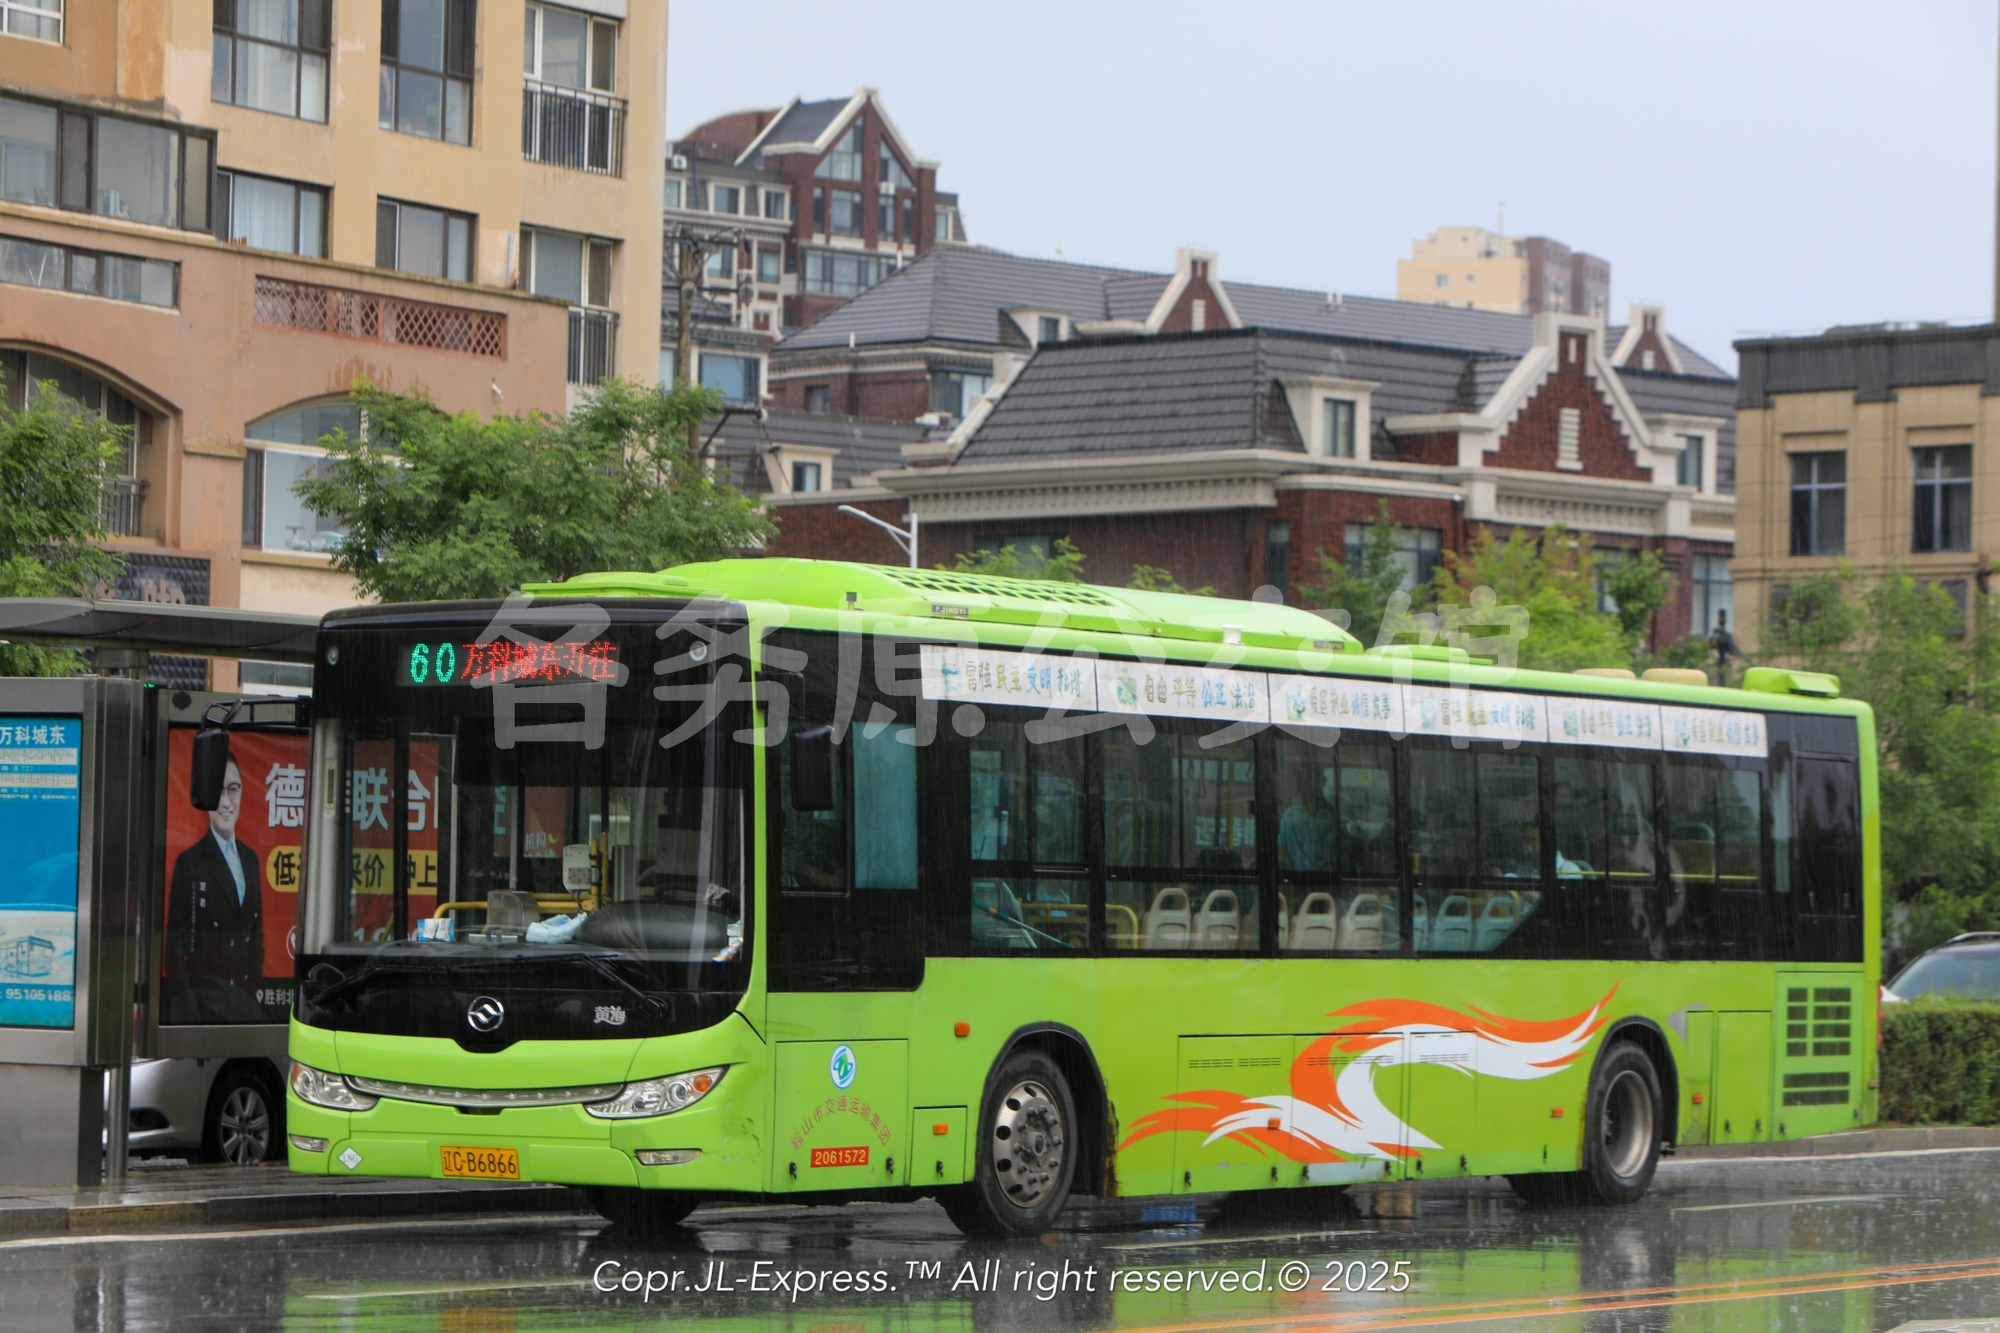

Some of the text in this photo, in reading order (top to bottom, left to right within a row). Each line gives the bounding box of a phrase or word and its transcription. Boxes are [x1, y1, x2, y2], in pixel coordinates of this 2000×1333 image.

[411, 643, 456, 684] 60
[0, 725, 66, 745] 万科城东
[5, 988, 72, 1002] 95105188
[814, 1149, 867, 1166] 2061572
